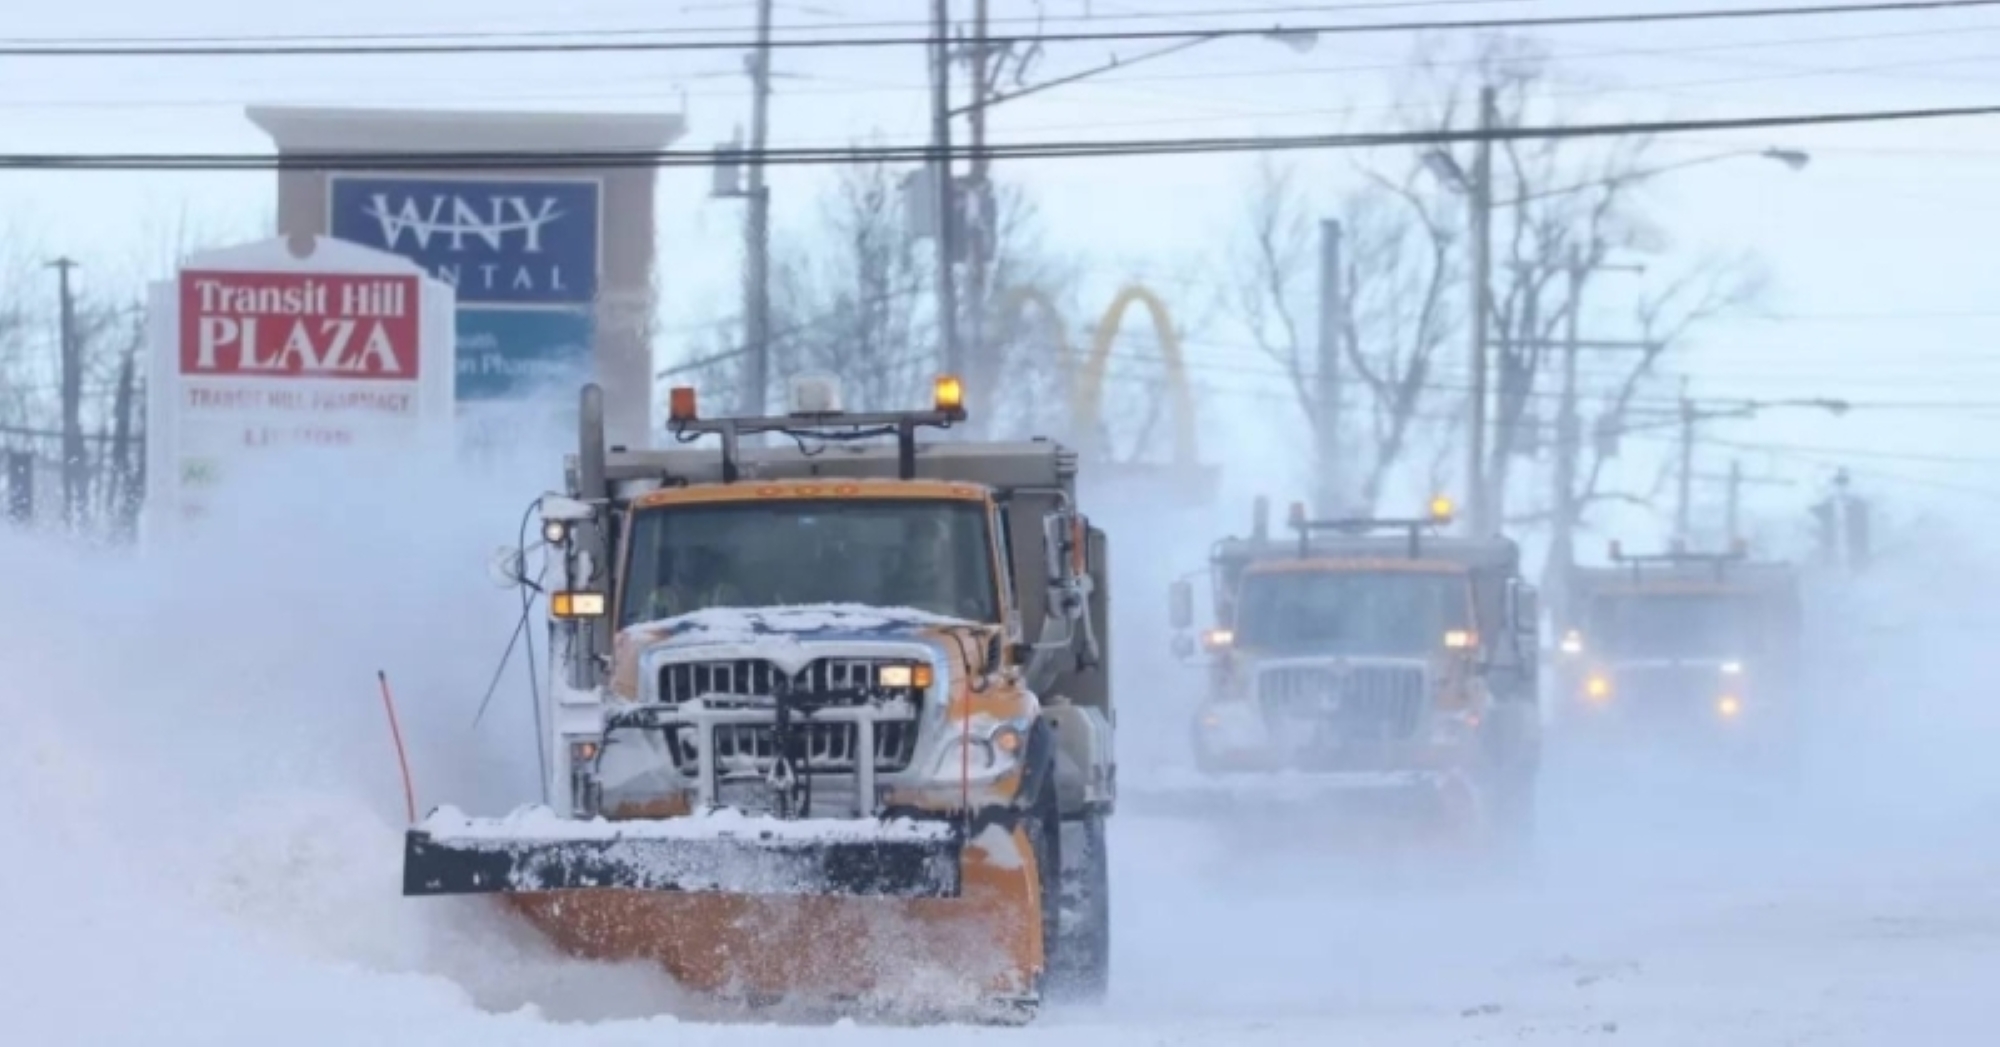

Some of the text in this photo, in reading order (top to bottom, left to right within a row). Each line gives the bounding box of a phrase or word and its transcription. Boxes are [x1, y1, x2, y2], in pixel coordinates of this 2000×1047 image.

[370, 194, 559, 252] WNY
[195, 279, 405, 317] Transit Hill
[437, 263, 567, 290] NTAL
[196, 316, 402, 372] PLAZA
